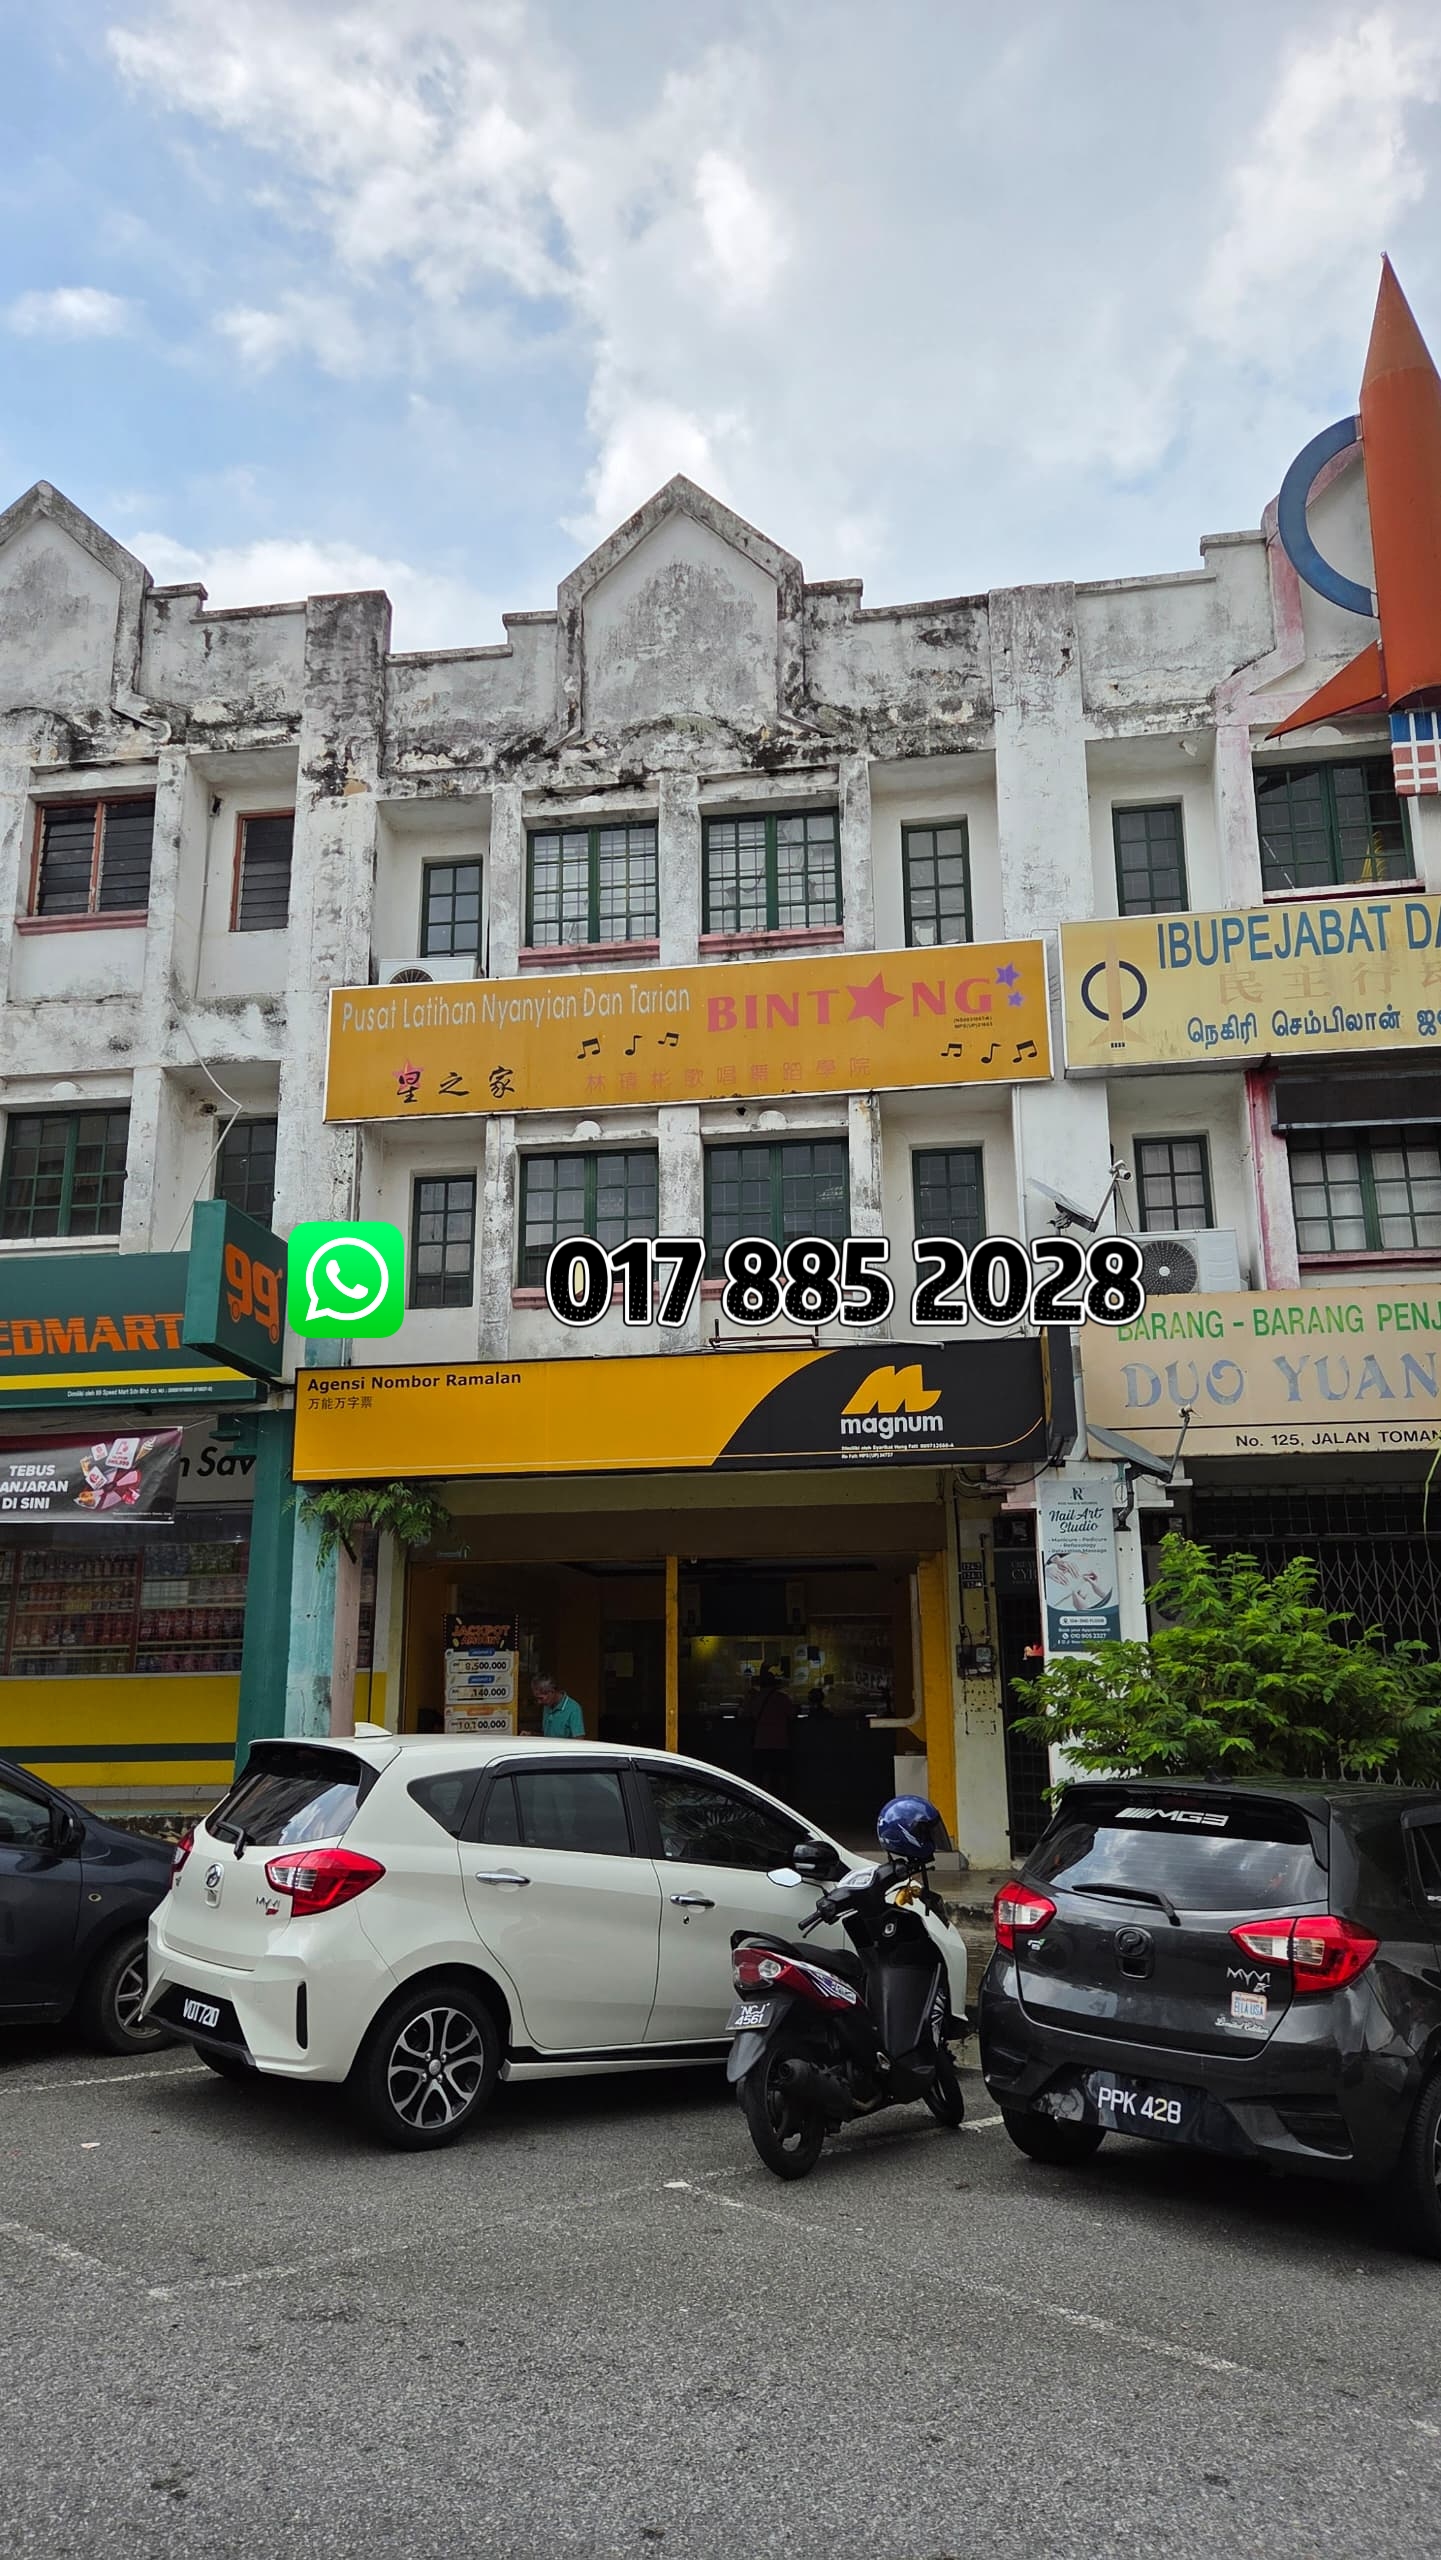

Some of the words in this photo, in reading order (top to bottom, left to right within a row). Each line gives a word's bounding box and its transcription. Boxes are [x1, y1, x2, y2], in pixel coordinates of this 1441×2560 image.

[1157, 904, 1392, 970] IBUPEJABAT
[1404, 902, 1441, 950] D
[342, 998, 398, 1033] Pusat
[402, 997, 477, 1030] Latihan
[482, 989, 578, 1031] Nyanyian
[583, 987, 624, 1018] Dan
[629, 983, 691, 1014] Tarian
[225, 1242, 284, 1345] 99
[1252, 1304, 1364, 1337] BARANG
[307, 1377, 366, 1394] Agensi
[371, 1375, 441, 1390] Nombor
[446, 1371, 522, 1387] Ramalan
[1120, 1359, 1245, 1409] DUO
[1272, 1352, 1440, 1402] YUAN
[840, 1415, 944, 1440] magnum
[1236, 1434, 1264, 1449] No.
[1311, 1430, 1371, 1446] JALAN
[9, 1464, 56, 1477] TEBUS
[0, 1480, 69, 1494] ANJARAN
[2, 1498, 17, 1510] DI
[20, 1497, 51, 1510] SINI
[1048, 1509, 1075, 1522] Nail
[1076, 1507, 1105, 1521] Art
[1059, 1520, 1099, 1534] Studio
[734, 2013, 764, 2025] 4561
[1098, 2086, 1138, 2116] PPK
[1140, 2096, 1182, 2124] 428
